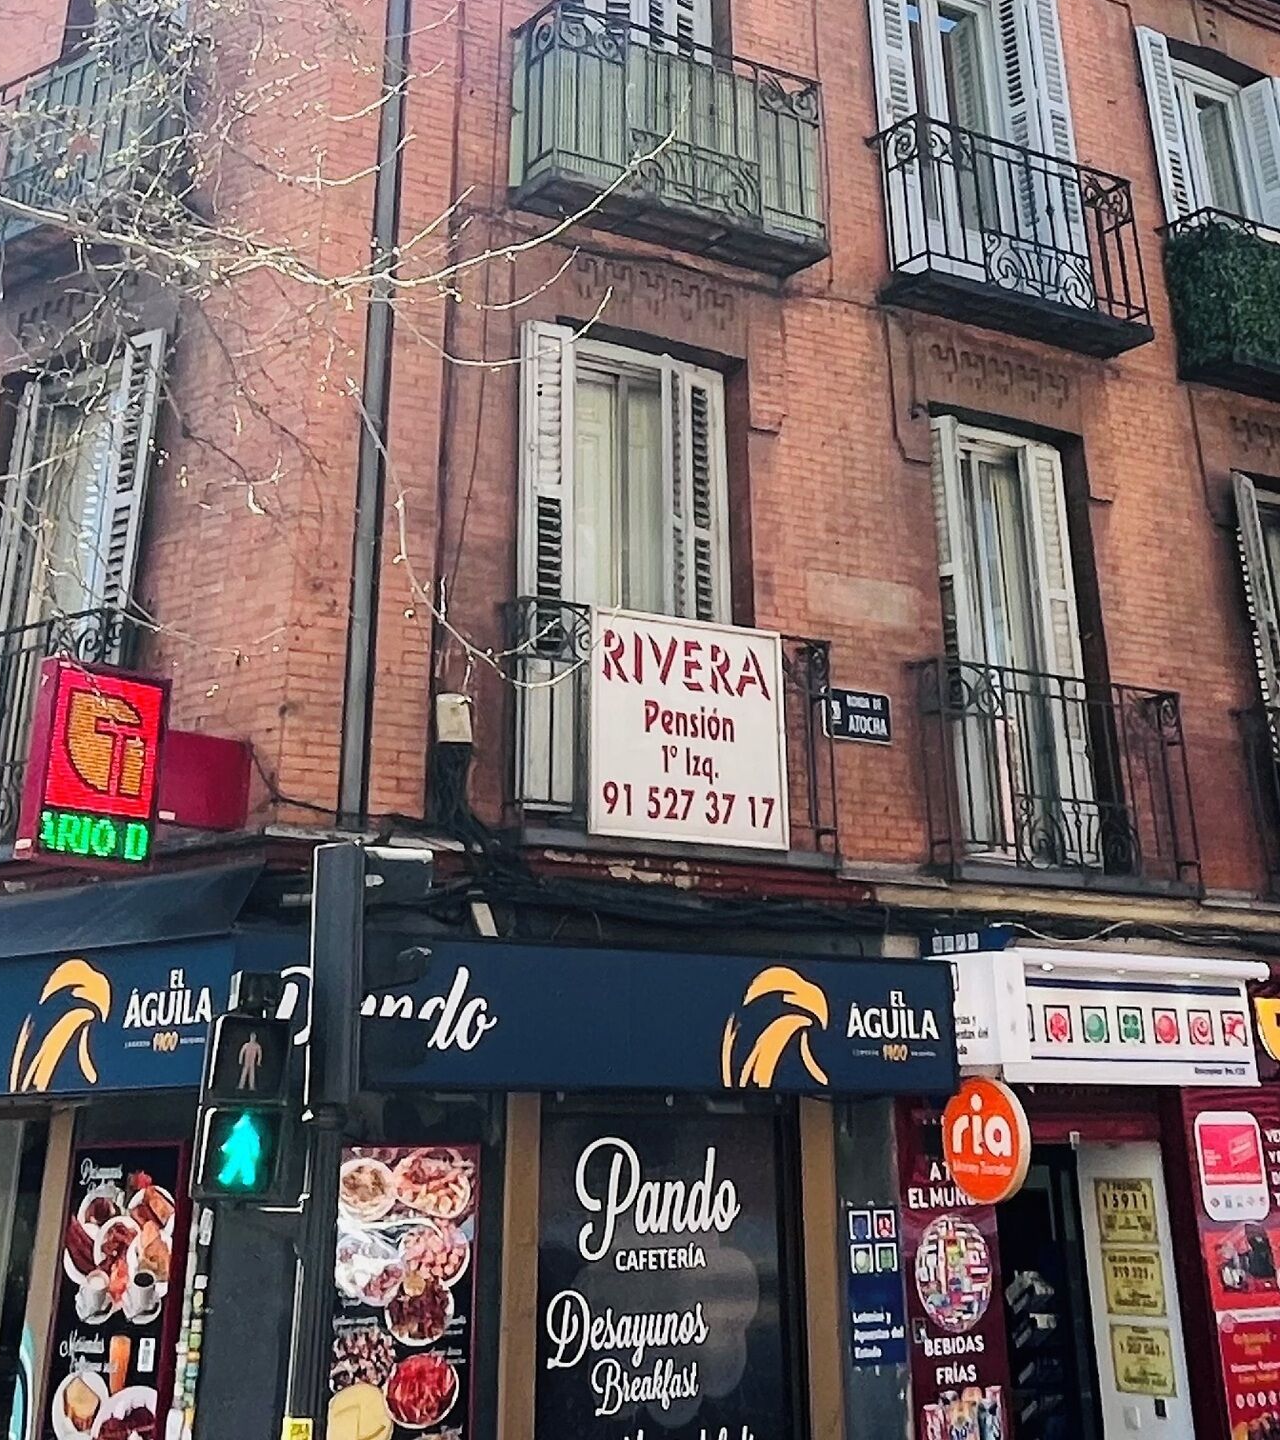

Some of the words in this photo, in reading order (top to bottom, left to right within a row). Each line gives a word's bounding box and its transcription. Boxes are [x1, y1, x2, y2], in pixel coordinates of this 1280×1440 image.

[603, 629, 771, 701] RIVERA
[644, 700, 734, 742] Pensión
[848, 714, 888, 736] ATOCHA
[662, 745, 678, 773] 1º
[686, 747, 719, 785] Izq.
[603, 781, 632, 816] 91
[647, 786, 695, 821] 527
[705, 791, 736, 824] 37
[748, 796, 775, 828] 17
[170, 968, 185, 989] EL
[122, 987, 212, 1029] ÁGUILA
[890, 990, 906, 1008] EL
[846, 1002, 940, 1040] ÁGUILA
[952, 1093, 1012, 1158] ria
[575, 1136, 741, 1261] Pando
[907, 1188, 929, 1209] EL
[929, 1186, 977, 1209] MUN
[1102, 1192, 1148, 1210] 15911
[615, 1242, 707, 1272] CAFETERÍA
[546, 1289, 710, 1369] Desayunos
[924, 1334, 985, 1357] BEBIDAS
[591, 1358, 700, 1417] Breakfast
[936, 1361, 977, 1386] FRÍAS
